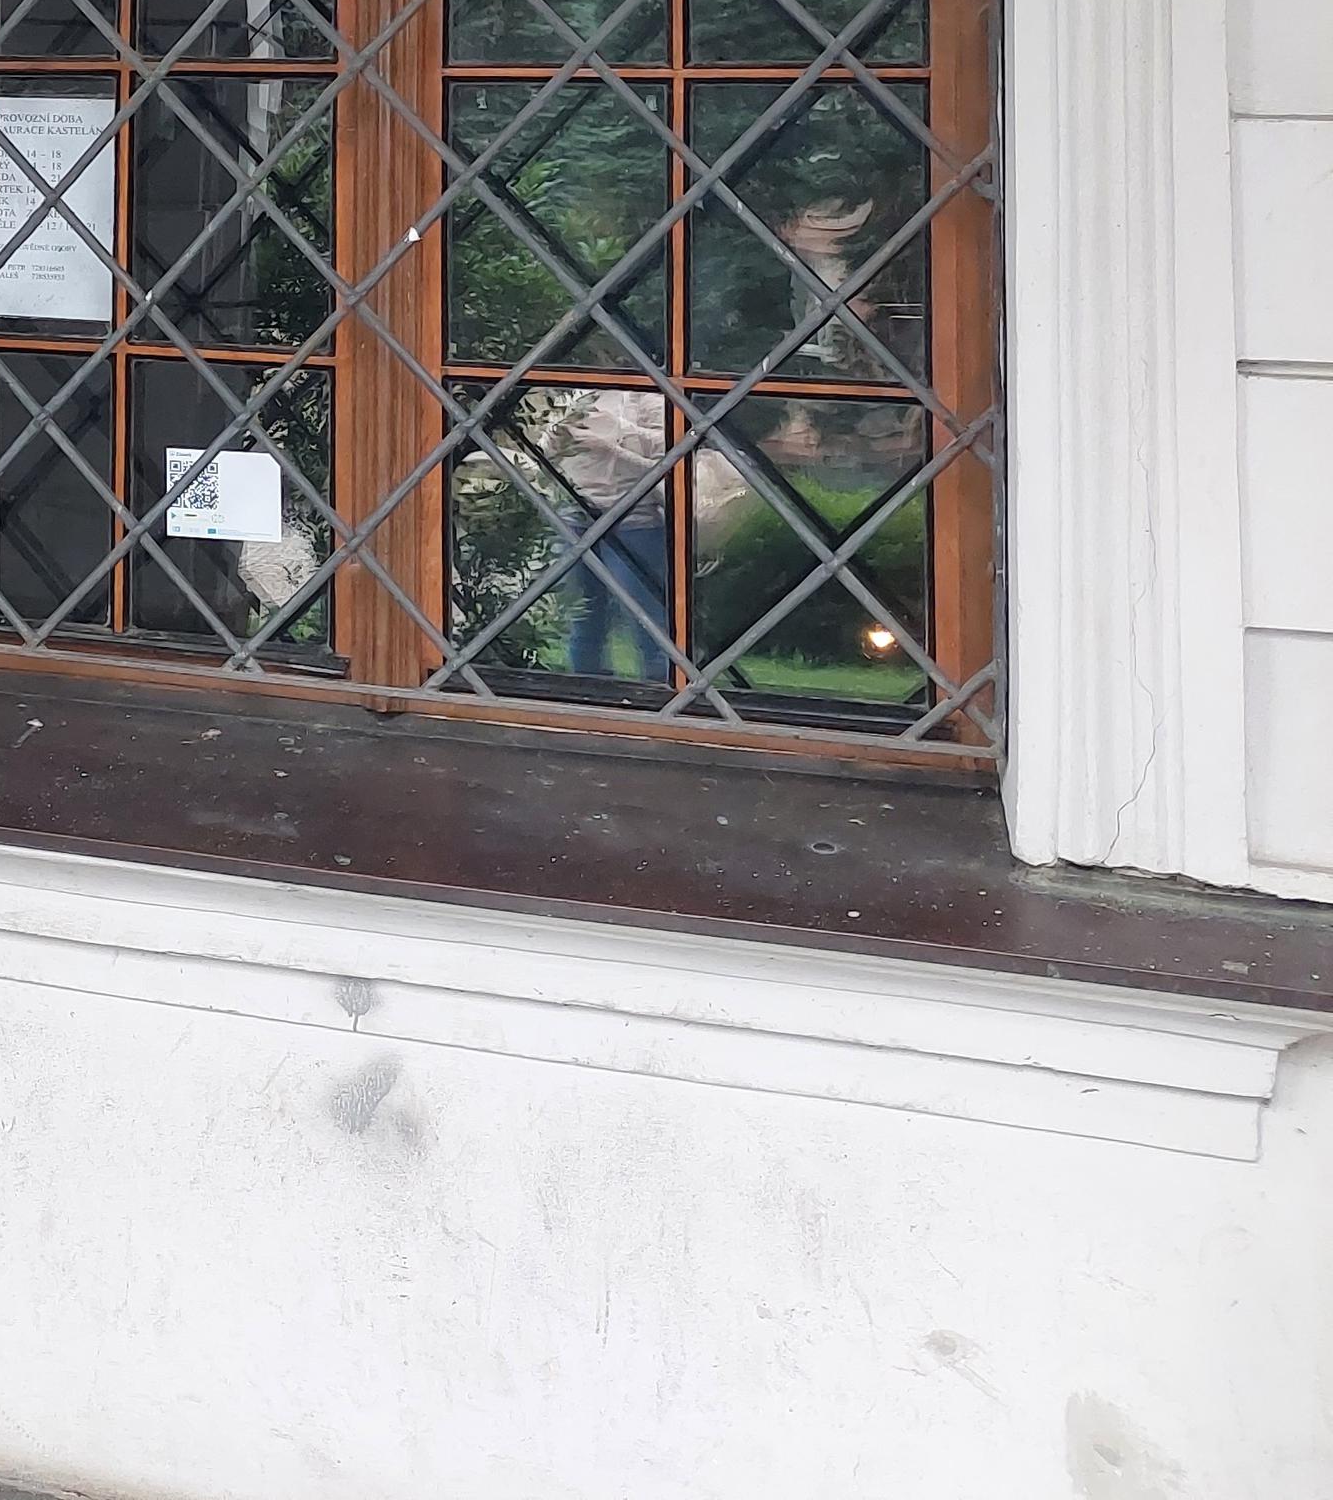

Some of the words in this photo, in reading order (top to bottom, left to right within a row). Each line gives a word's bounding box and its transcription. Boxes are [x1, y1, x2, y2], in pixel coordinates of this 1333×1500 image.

[52, 113, 84, 125] DOBA
[26, 149, 37, 159] 14
[51, 149, 62, 159] 18
[51, 161, 62, 171] 18
